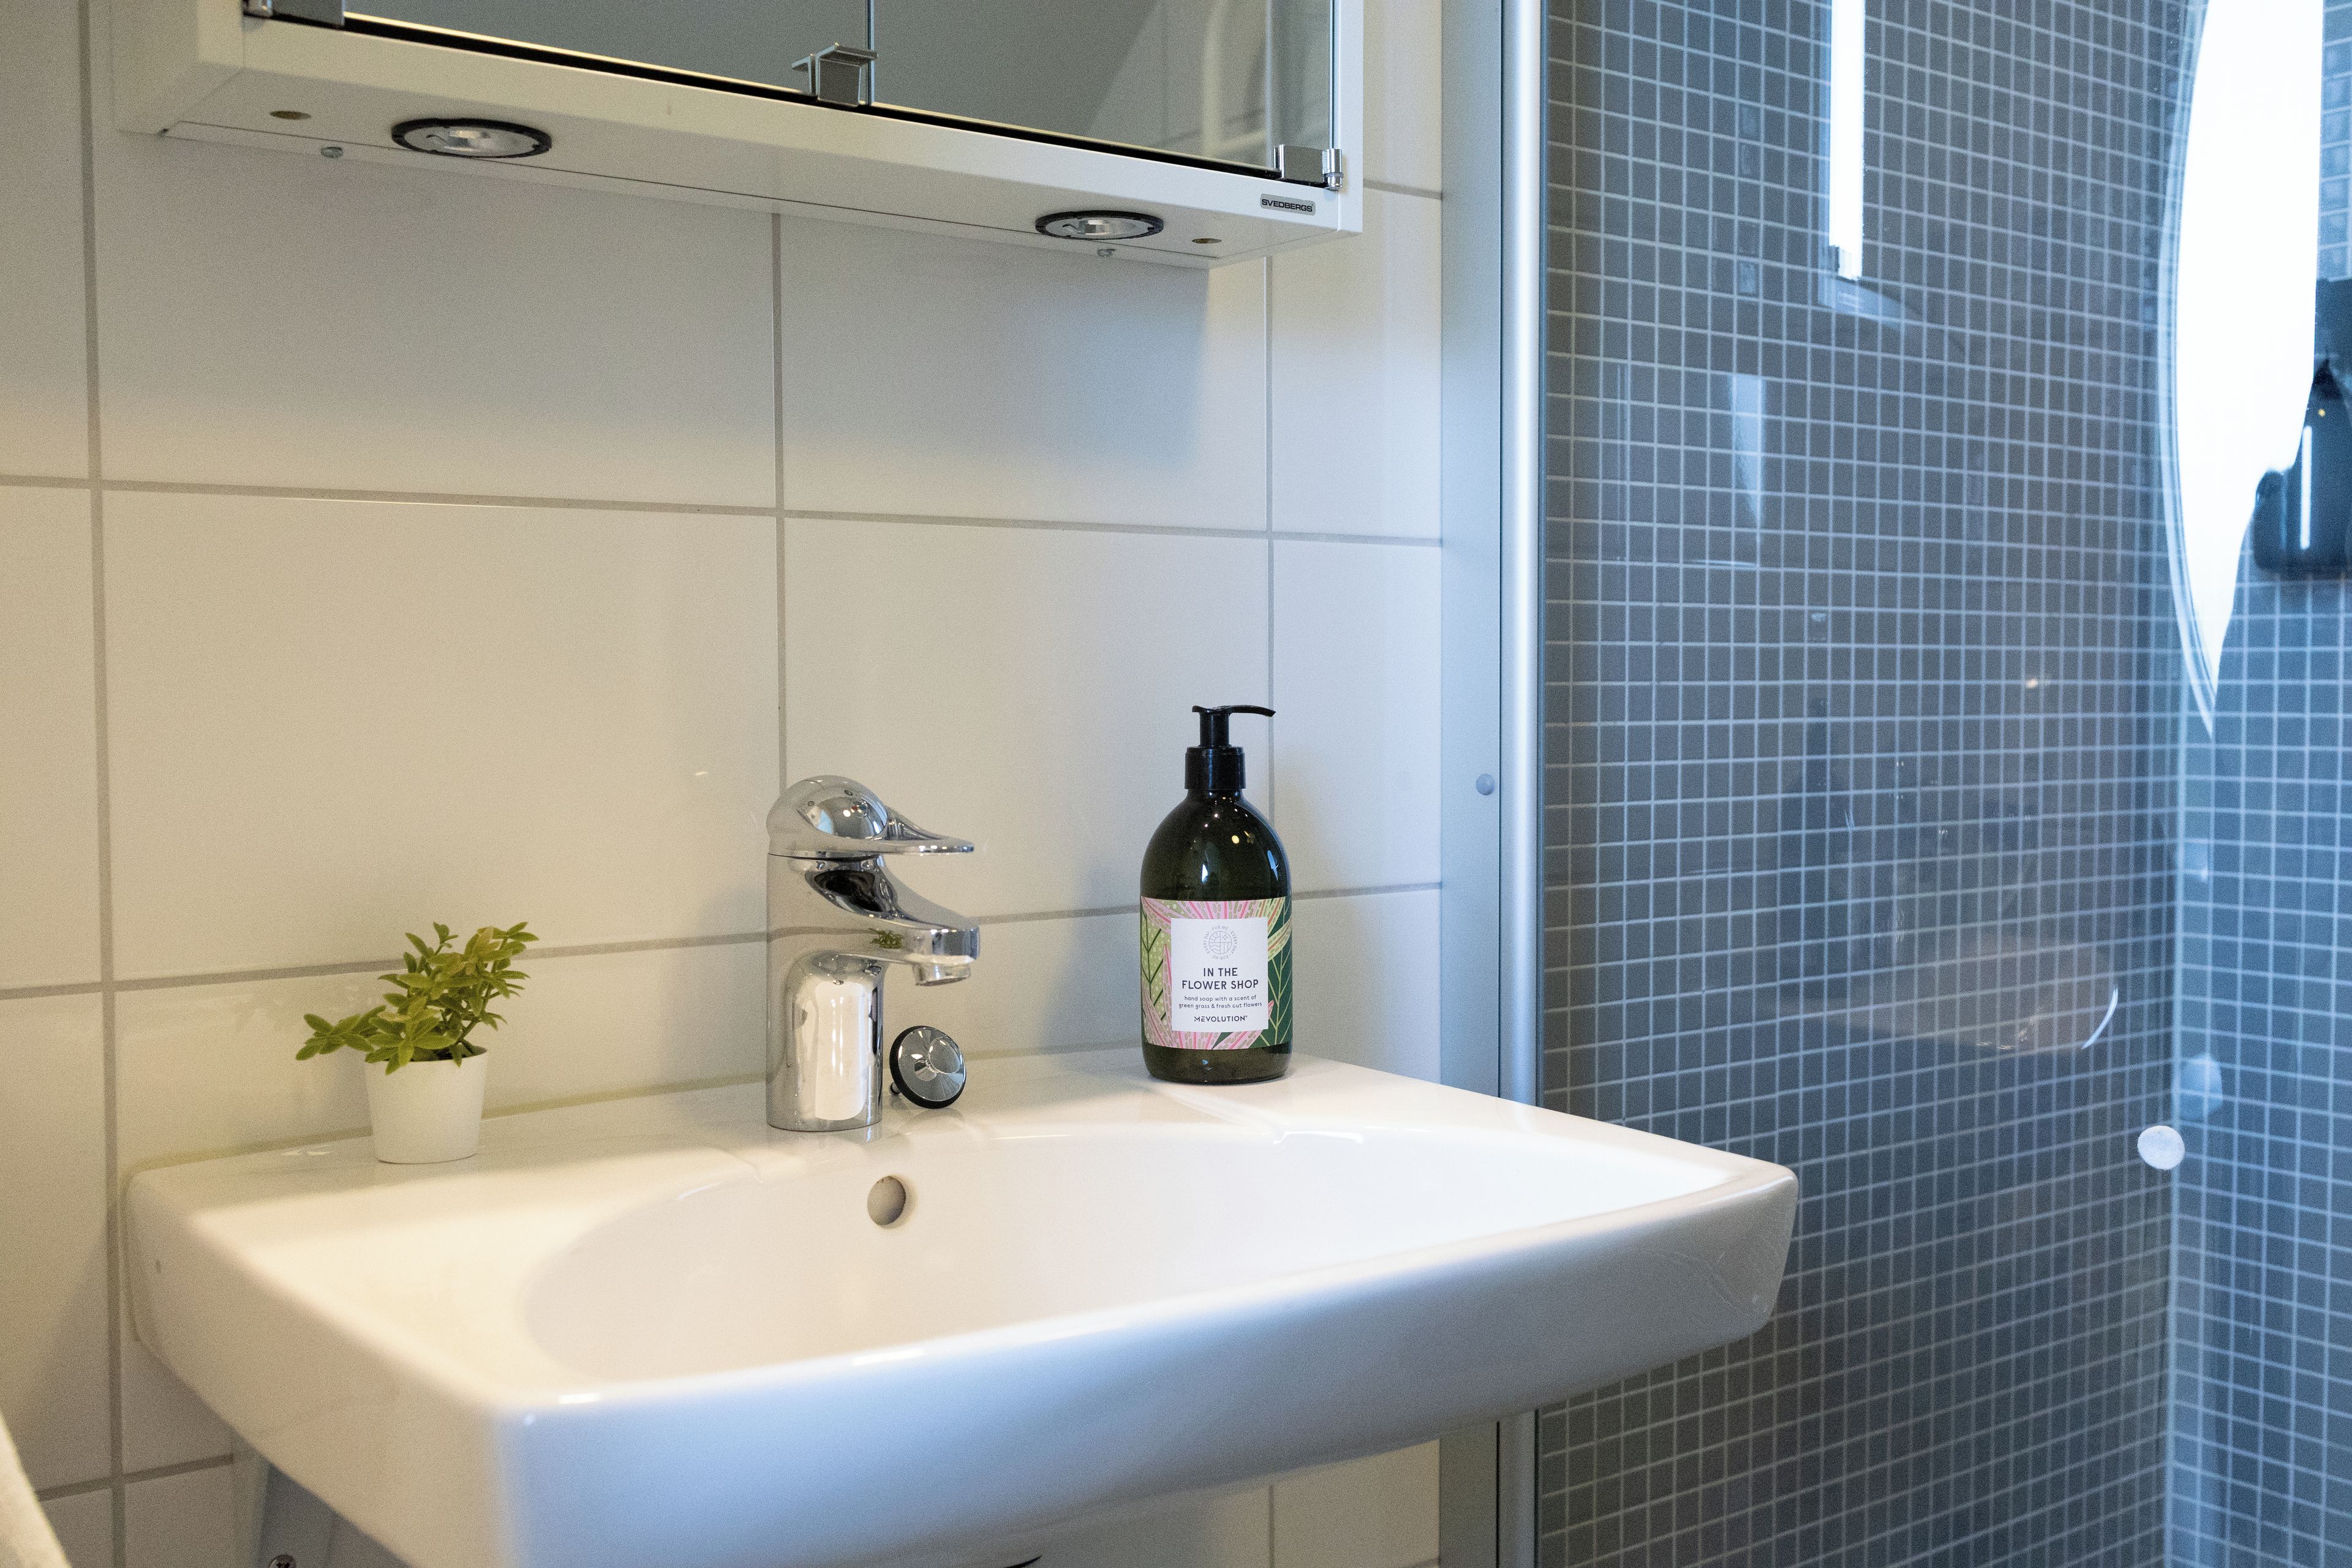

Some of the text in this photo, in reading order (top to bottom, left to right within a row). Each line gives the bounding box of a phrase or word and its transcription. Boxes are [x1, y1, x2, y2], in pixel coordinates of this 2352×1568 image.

[1262, 199, 1313, 212] SVEDBERGS
[1203, 967, 1238, 976] IN THE
[1182, 979, 1259, 990] FLOWER SHOP
